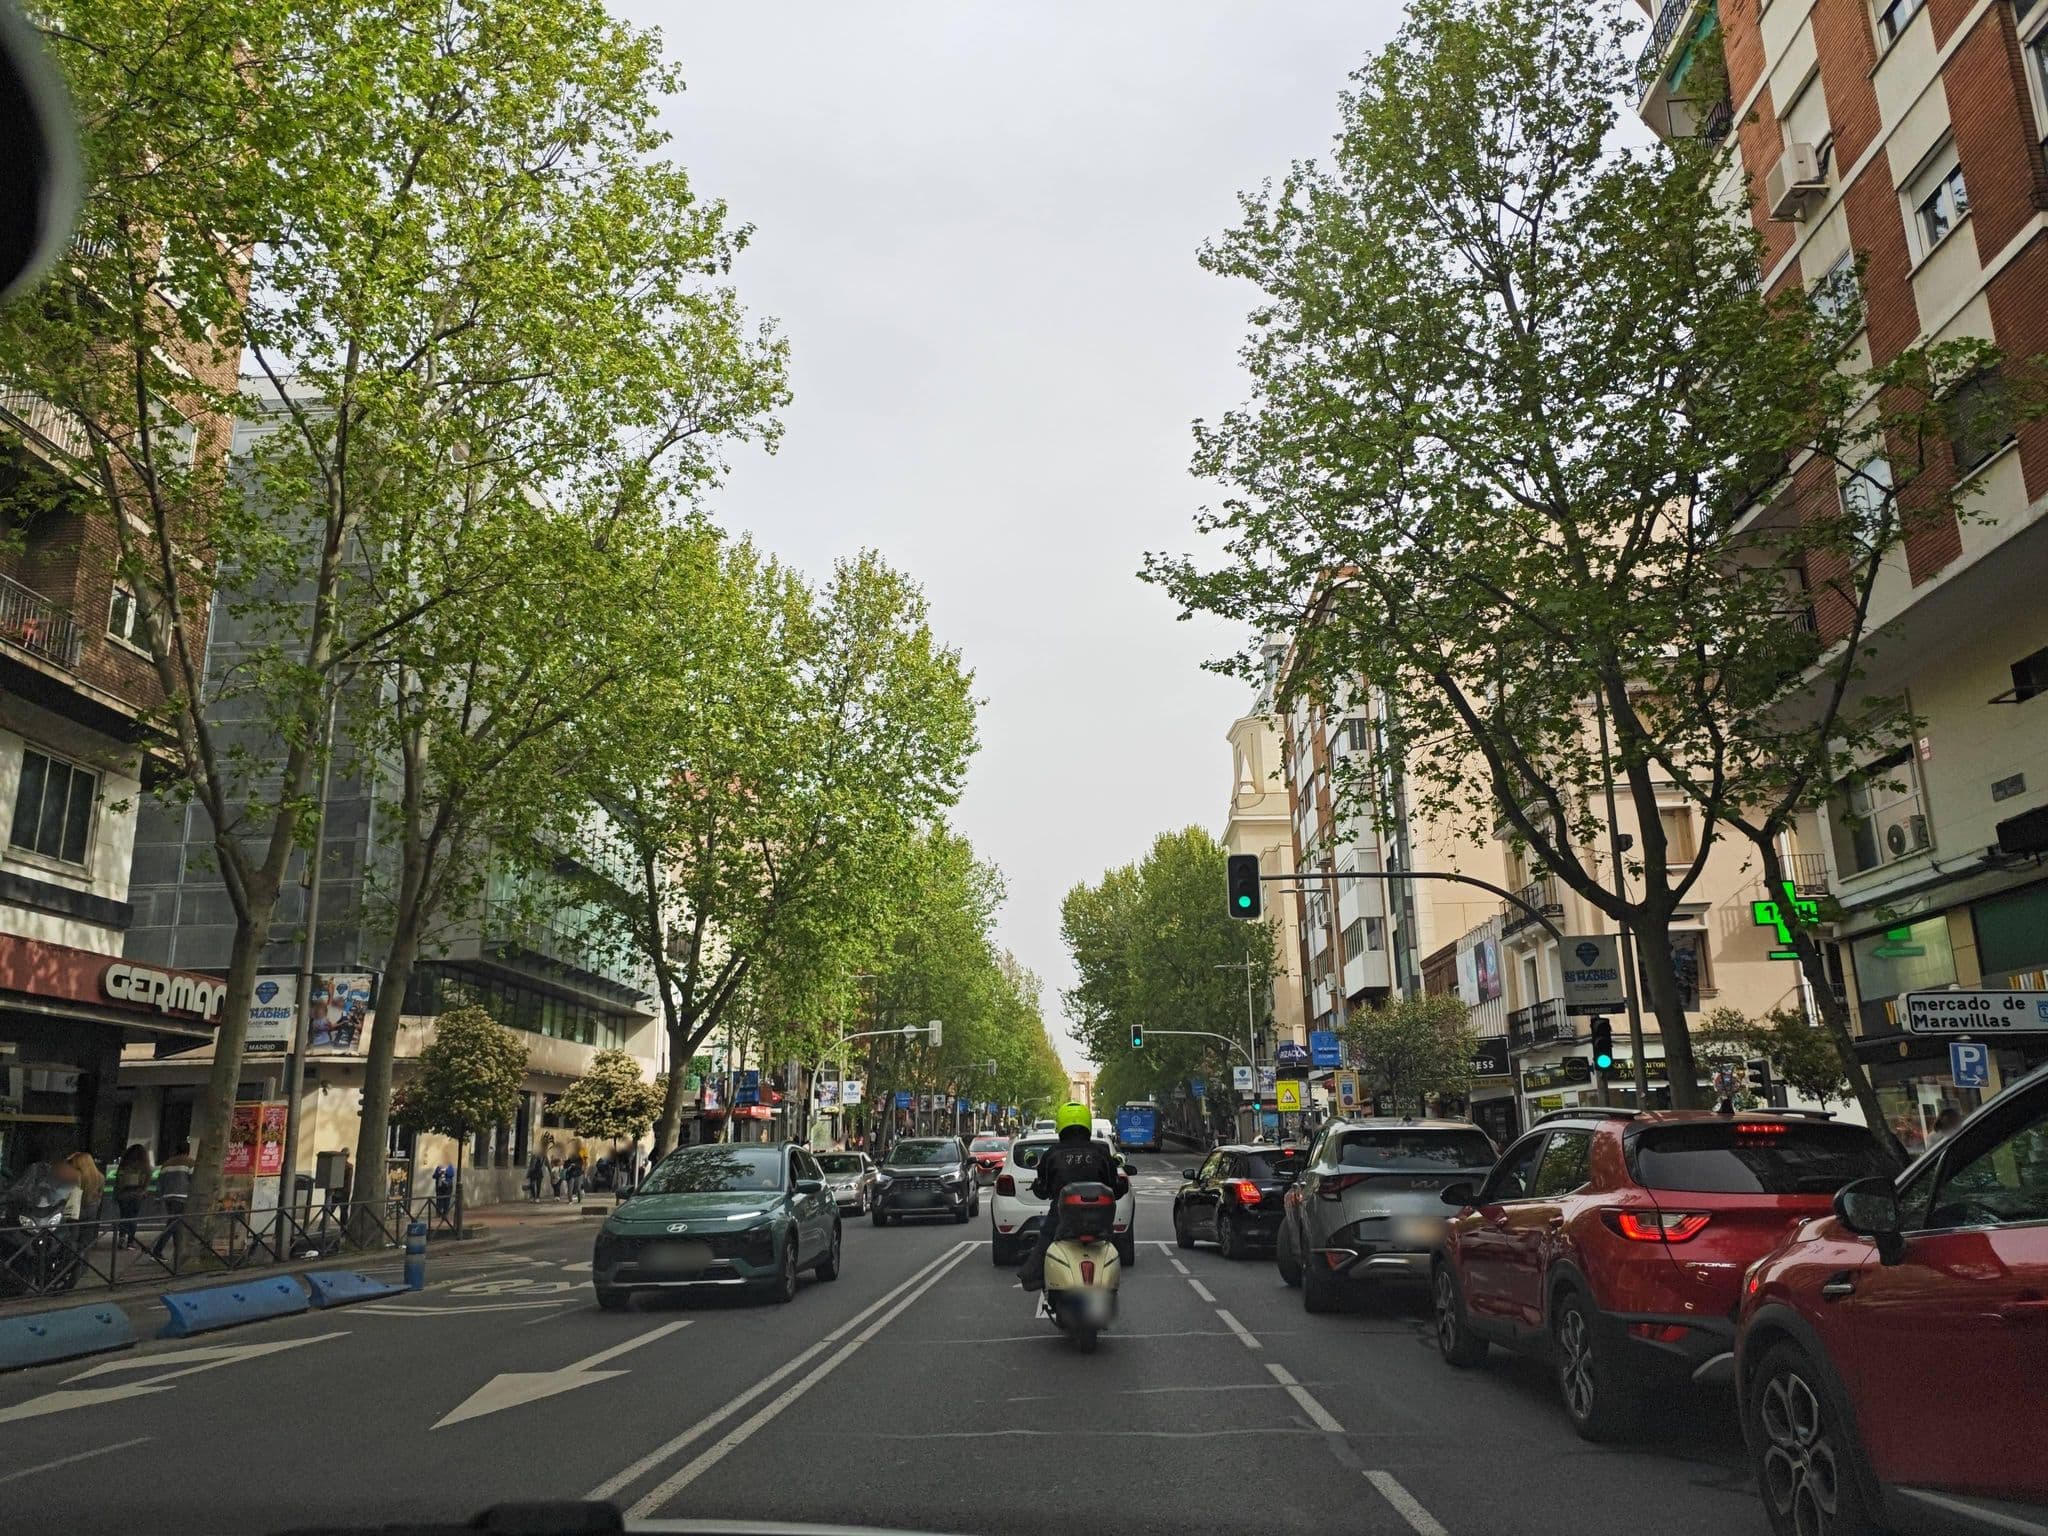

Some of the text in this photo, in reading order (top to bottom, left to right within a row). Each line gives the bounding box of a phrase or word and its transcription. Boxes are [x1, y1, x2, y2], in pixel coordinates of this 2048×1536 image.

[1911, 996, 2026, 1012] mercado de
[1913, 1013, 2011, 1029] Maravillas
[248, 1043, 276, 1051] MADRID
[1957, 1046, 1981, 1072] P
